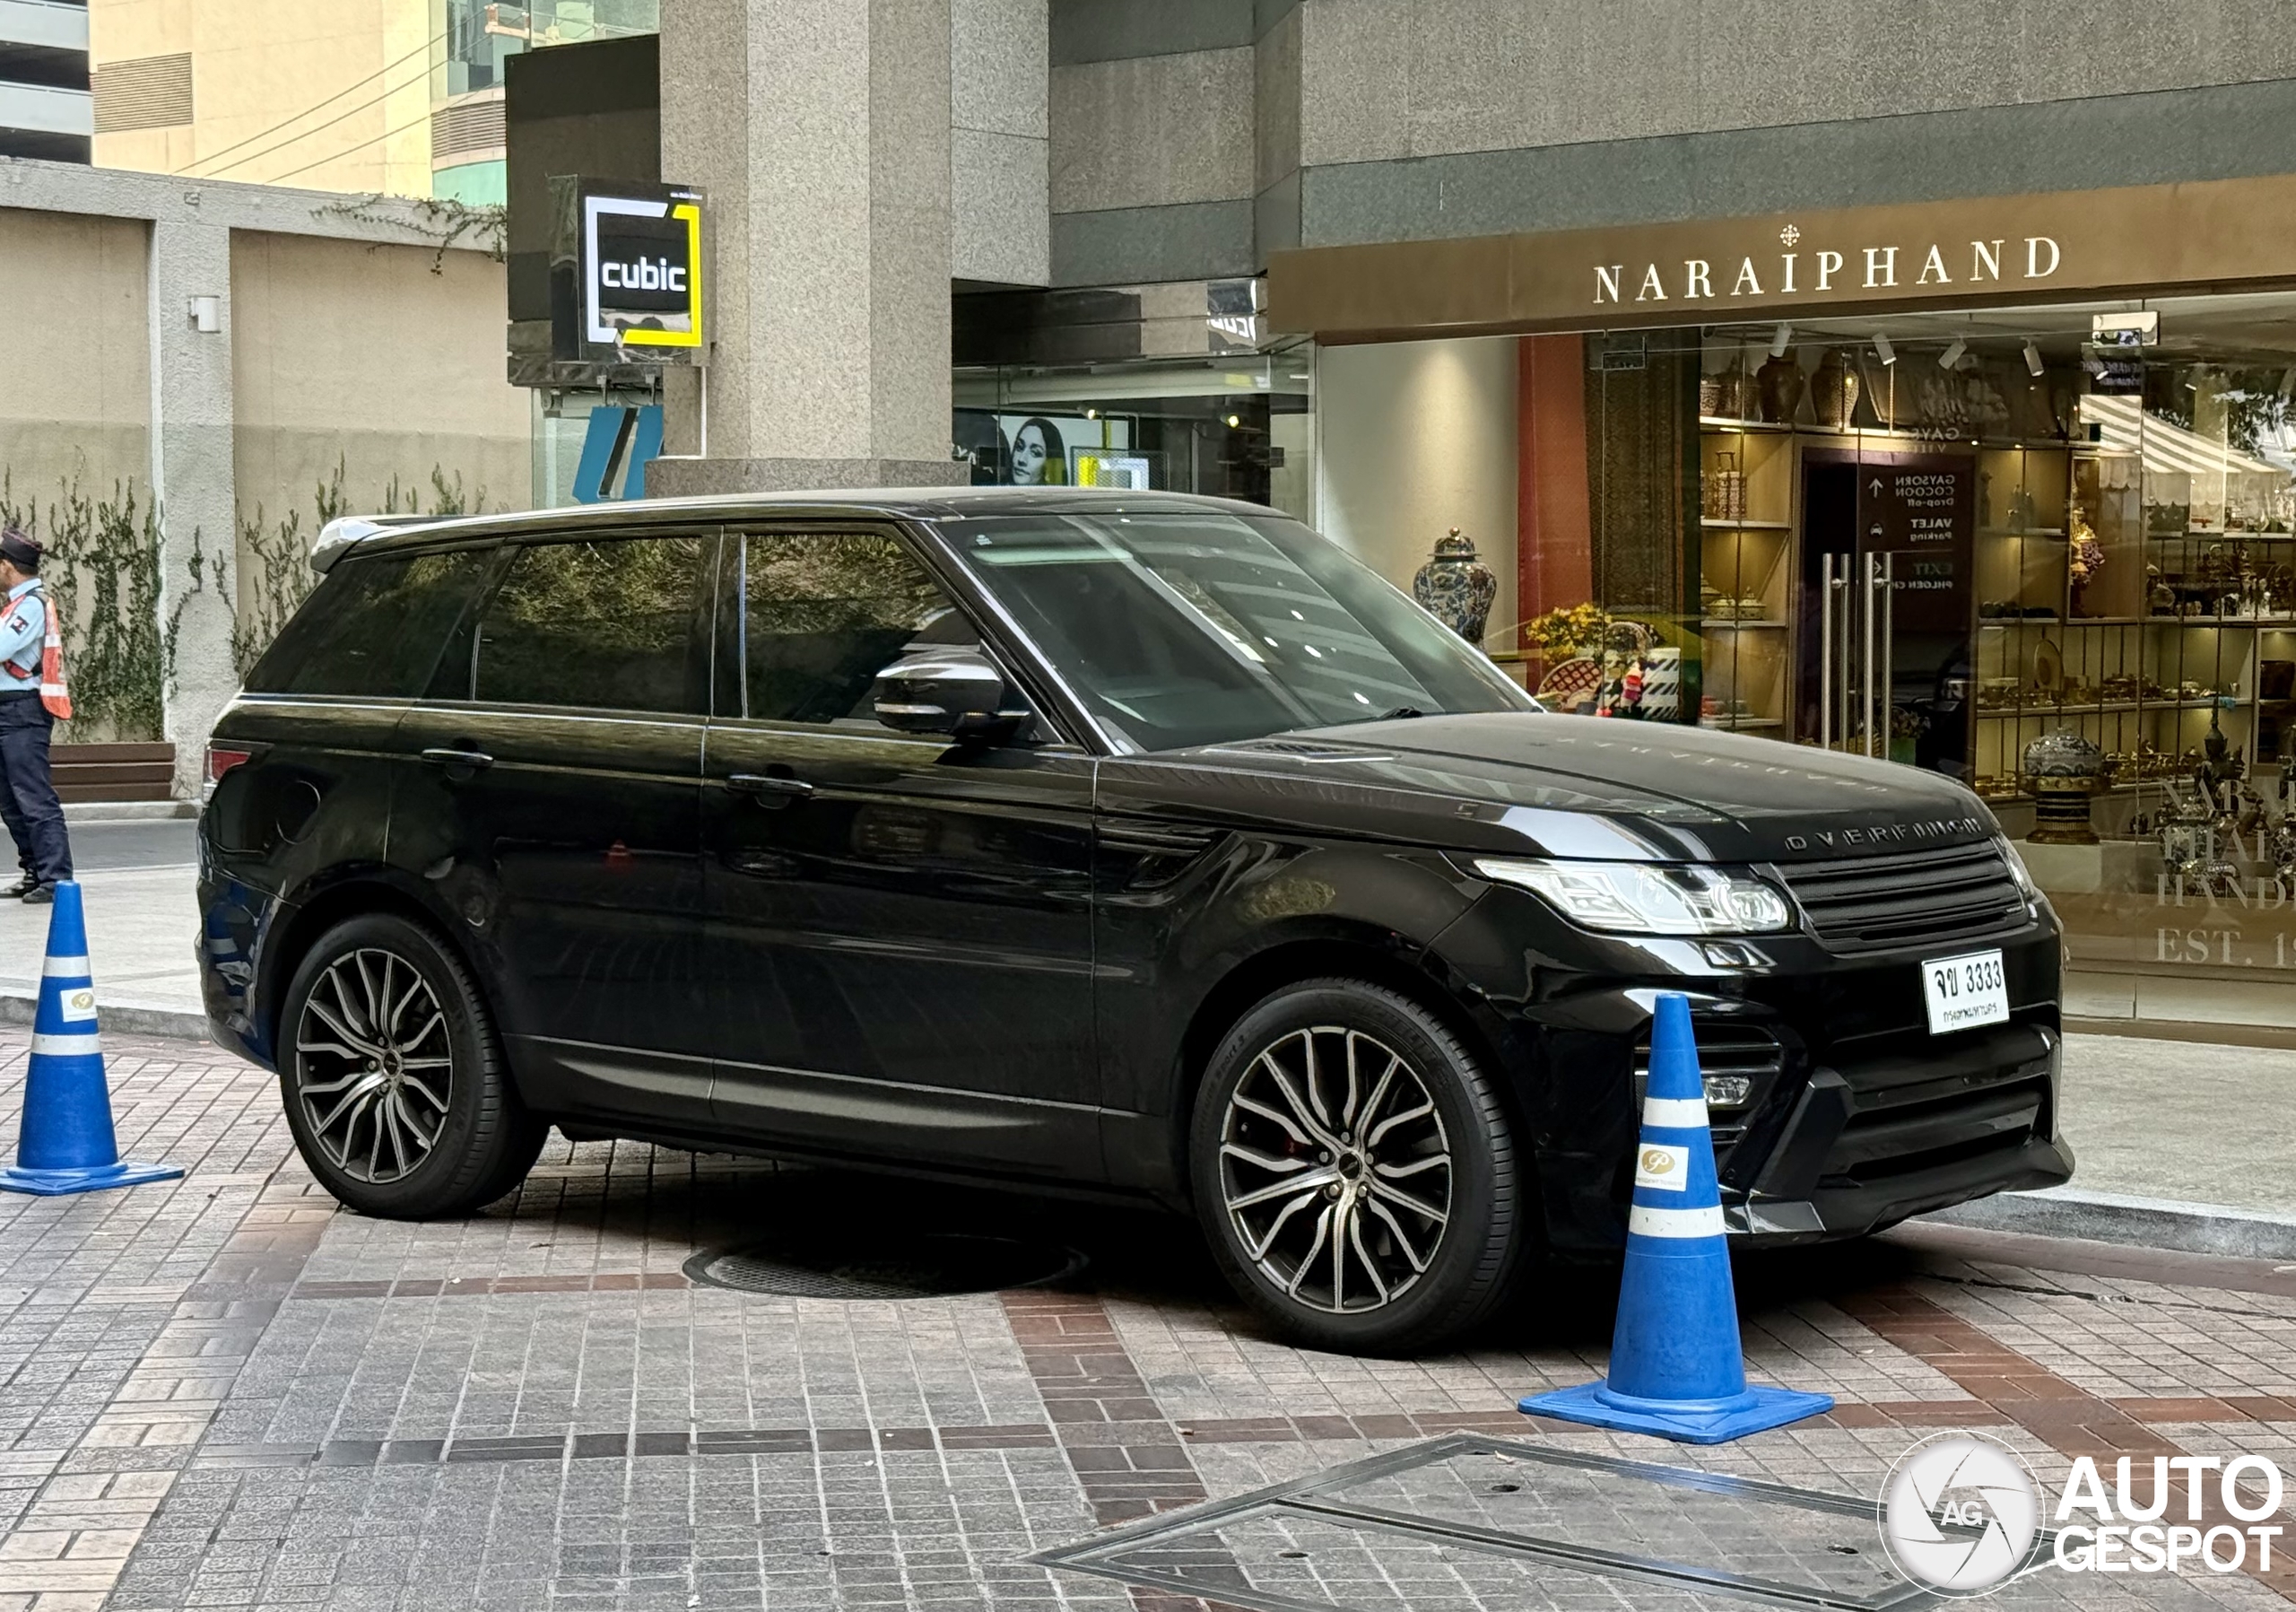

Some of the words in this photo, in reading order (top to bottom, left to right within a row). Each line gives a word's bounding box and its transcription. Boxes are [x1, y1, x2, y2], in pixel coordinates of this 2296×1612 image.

[602, 257, 687, 292] cubic
[1593, 237, 2060, 303] NARAIPHAND
[2155, 874, 2296, 910] HAND
[2155, 928, 2253, 964] EST.
[1966, 960, 2002, 993] 3333
